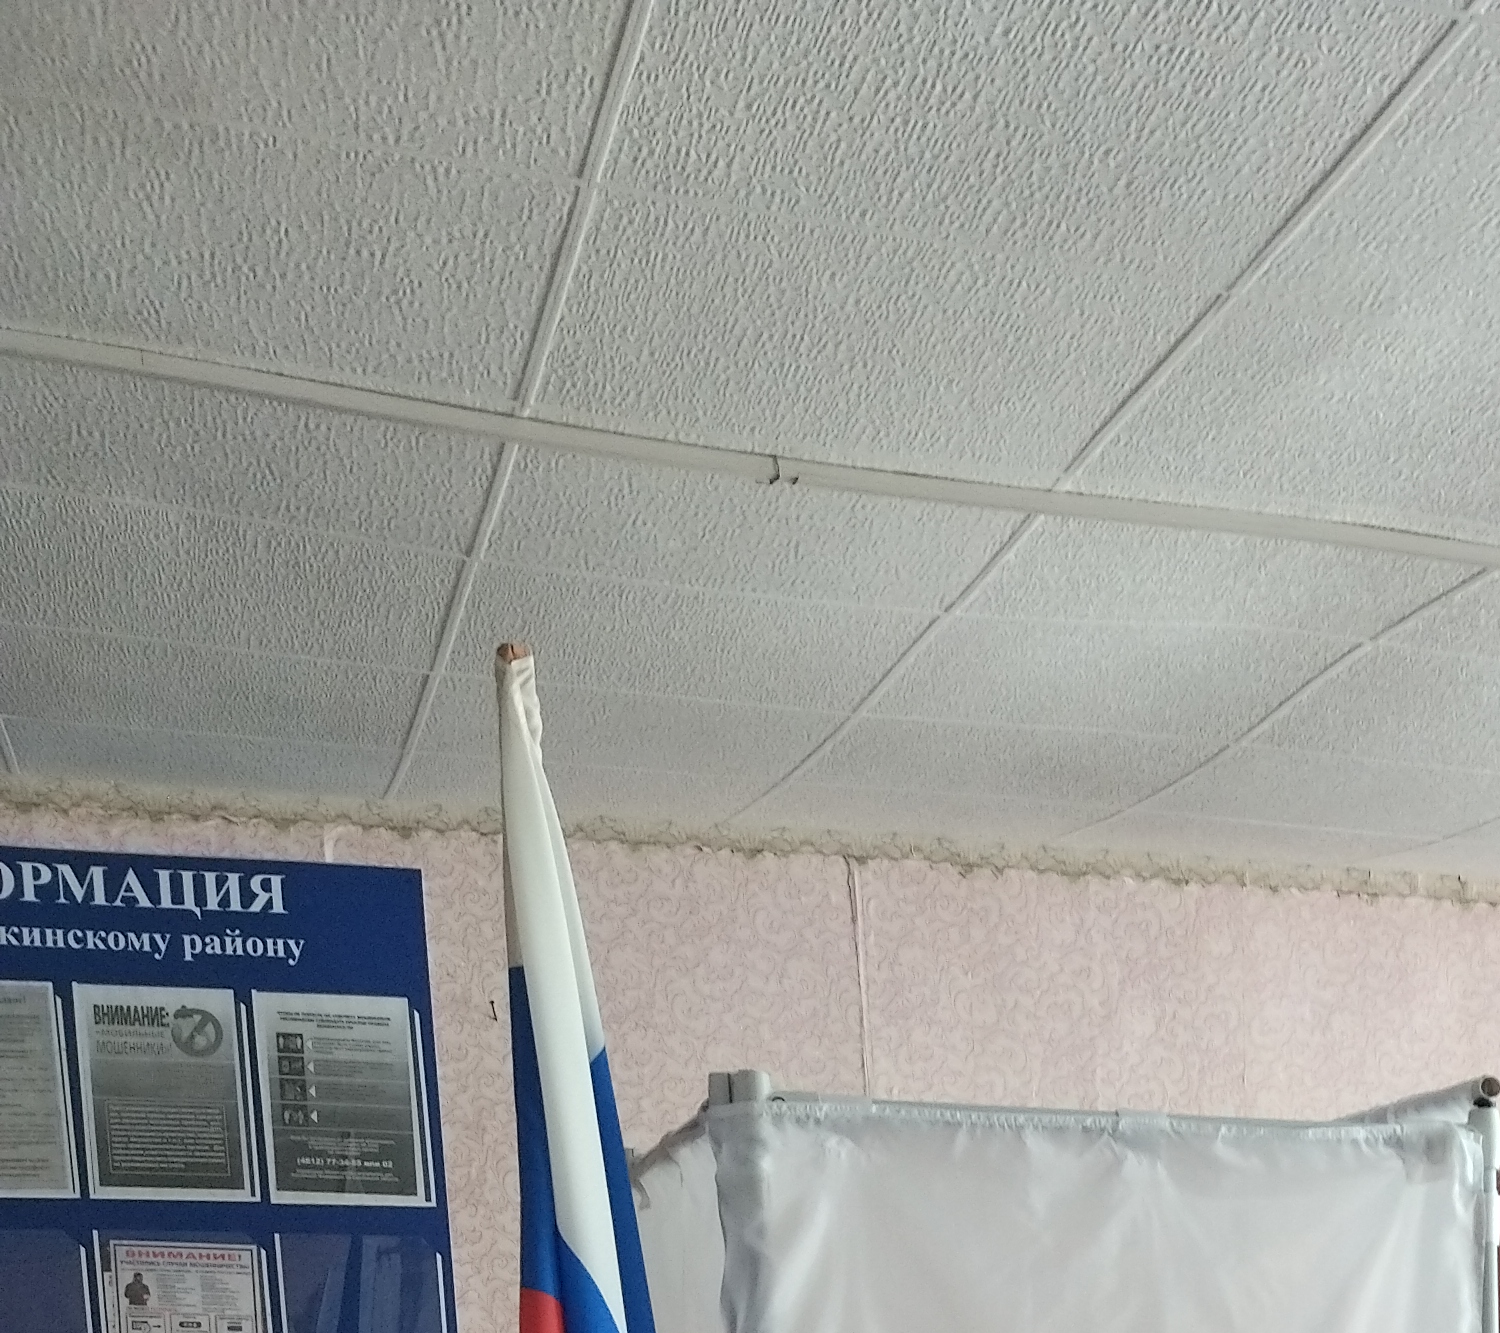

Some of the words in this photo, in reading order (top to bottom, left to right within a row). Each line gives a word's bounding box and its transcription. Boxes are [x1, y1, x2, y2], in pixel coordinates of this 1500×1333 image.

[0, 925, 172, 960] кинскому
[182, 928, 305, 966] району
[125, 1250, 242, 1262] ВНИМАНИЕ!
